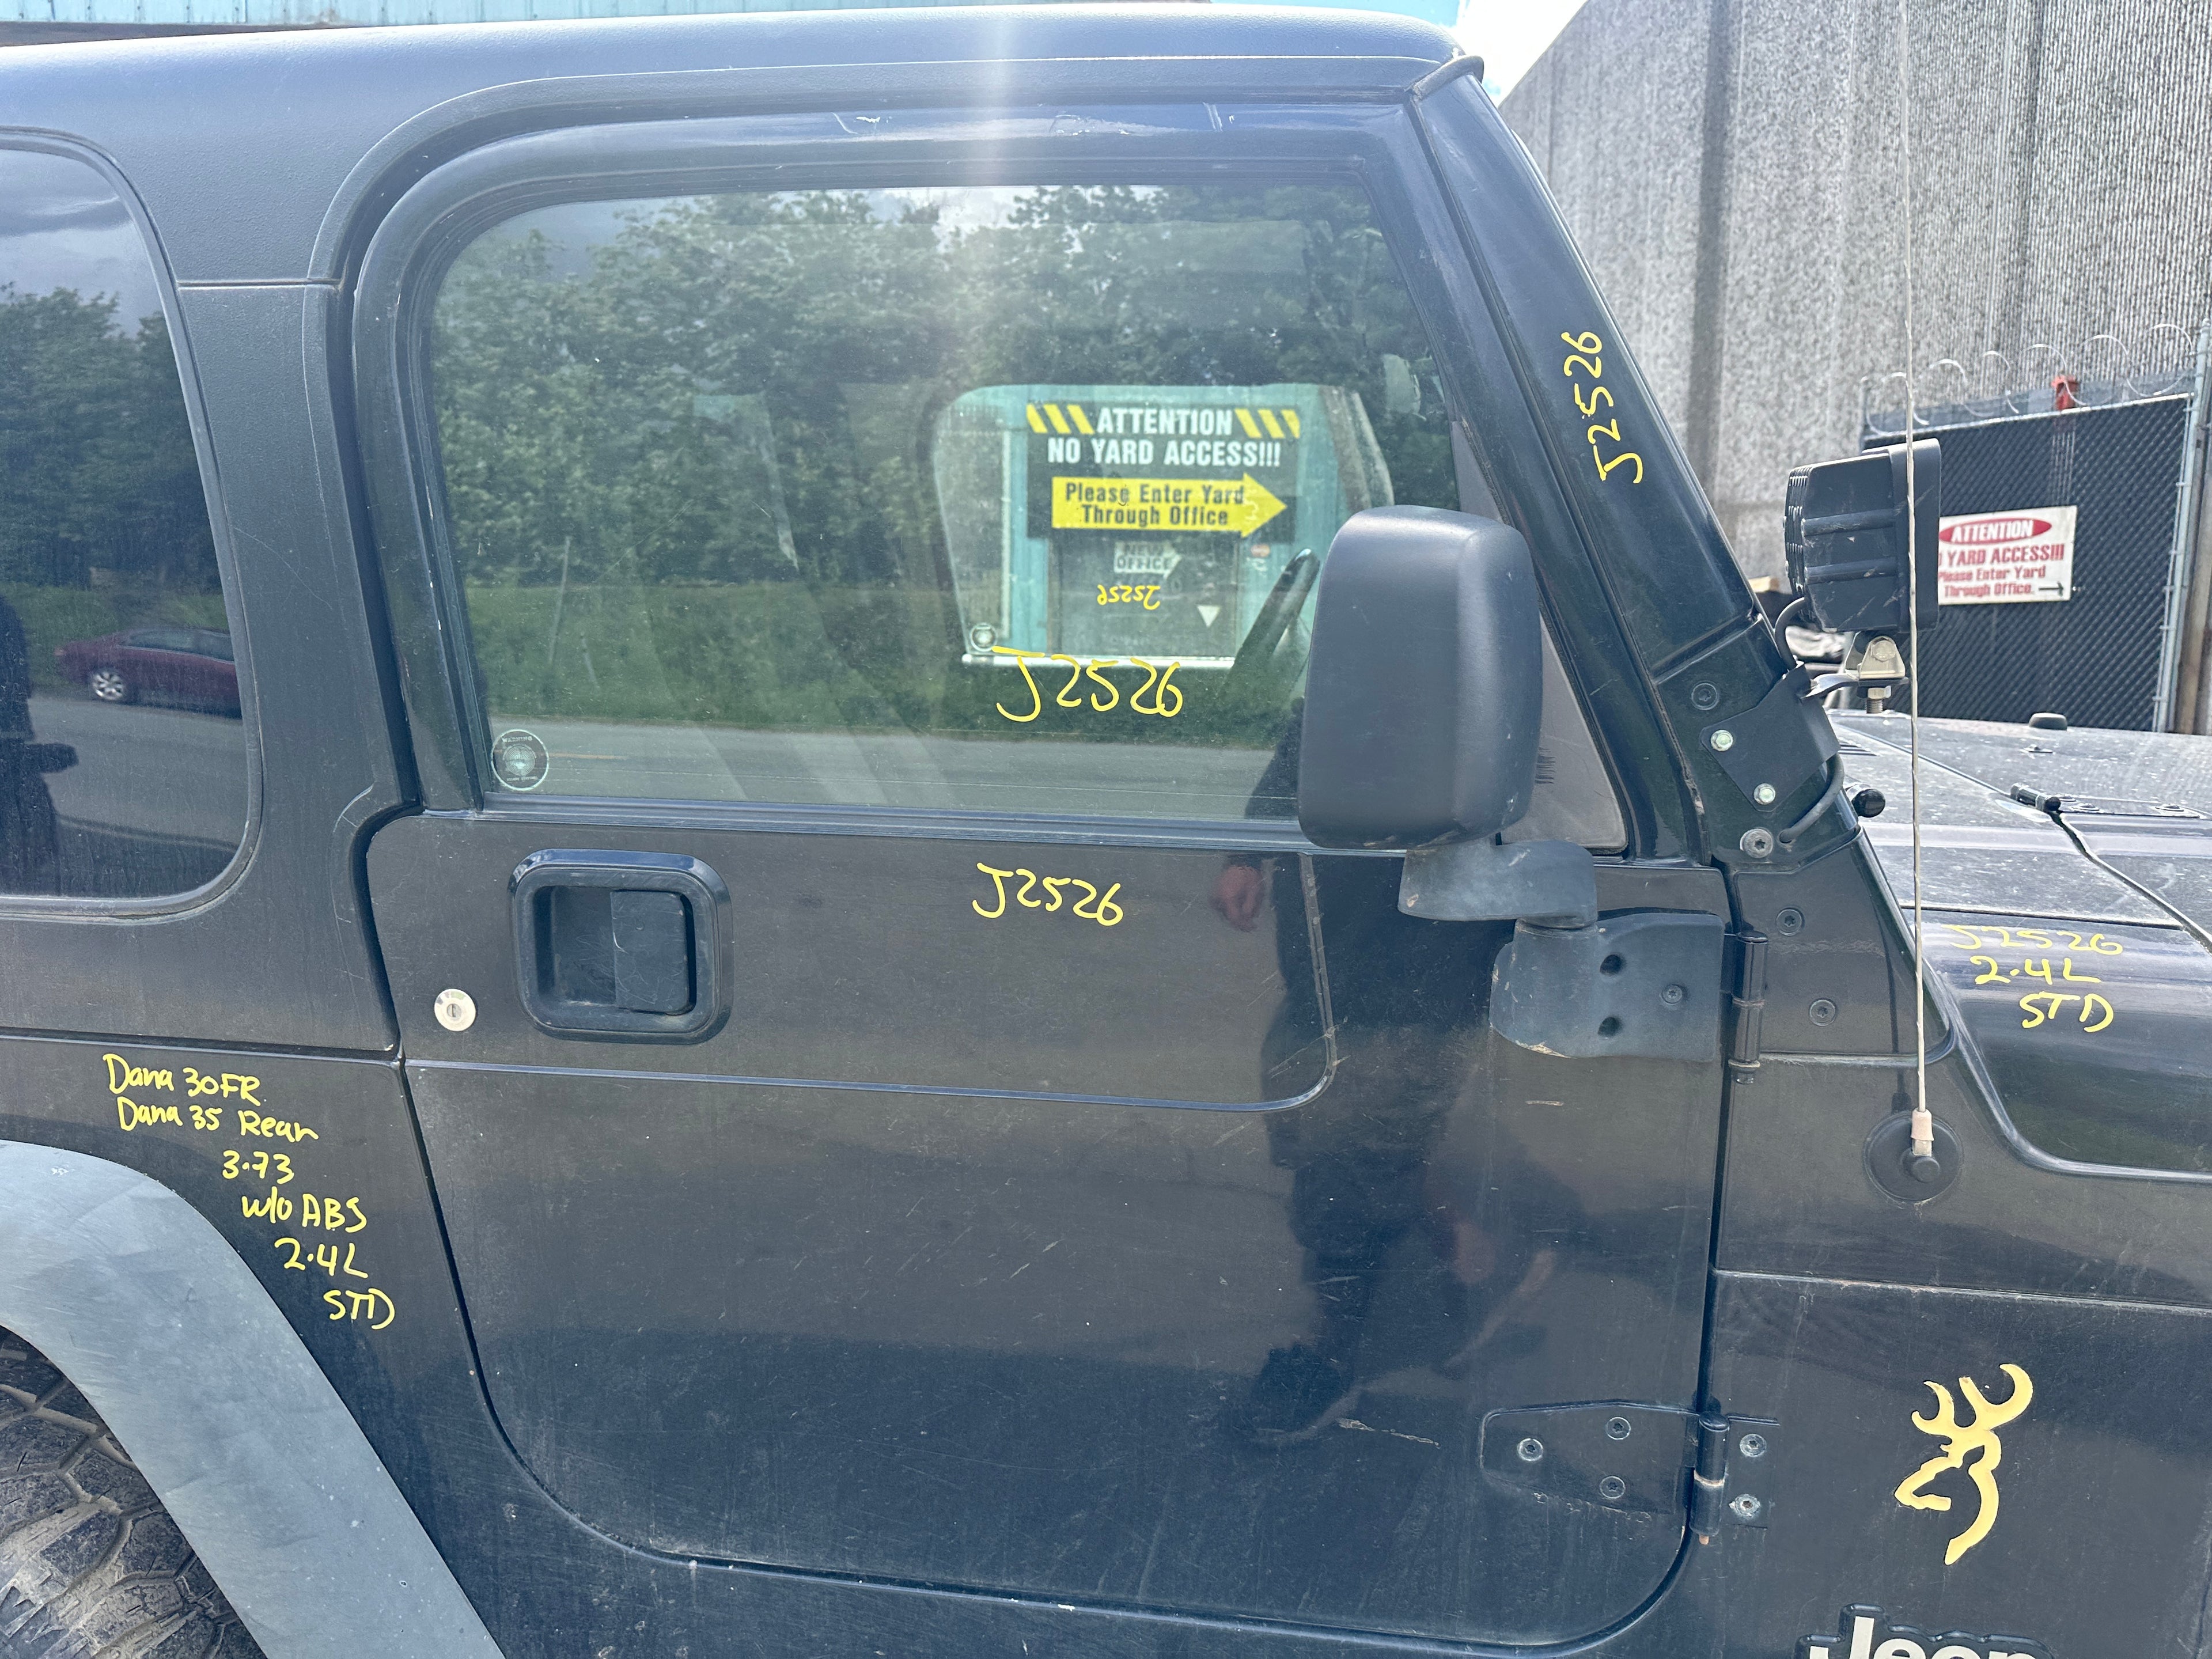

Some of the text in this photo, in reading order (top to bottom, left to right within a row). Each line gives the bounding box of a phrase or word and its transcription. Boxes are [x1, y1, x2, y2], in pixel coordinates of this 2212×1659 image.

[1097, 407, 1232, 435] ATTENTION
[1562, 332, 1643, 483] J2526
[1047, 437, 1281, 467] NO YARD ACCESS!!!
[1066, 482, 1244, 505] Please Enter Yard
[1081, 505, 1228, 528] Through Office
[1950, 520, 2033, 543] ATTENTION
[1118, 555, 1172, 570] OFFICE
[1947, 548, 1986, 567] YARD
[1991, 543, 2065, 563] ACCESS!!!
[1976, 567, 2010, 580] Enter
[2014, 564, 2046, 579] Yard
[1944, 584, 1990, 599] Through
[991, 645, 1183, 722] J2526
[972, 862, 1124, 926] J2526
[1941, 924, 2123, 955] J2526
[1970, 955, 2102, 984] 2.4L
[2020, 991, 2114, 1033] STD
[103, 1053, 175, 1094] Dana
[117, 1096, 319, 1142] Dana 35 Rear
[302, 1193, 368, 1233] ABS
[323, 1288, 396, 1329] STD
